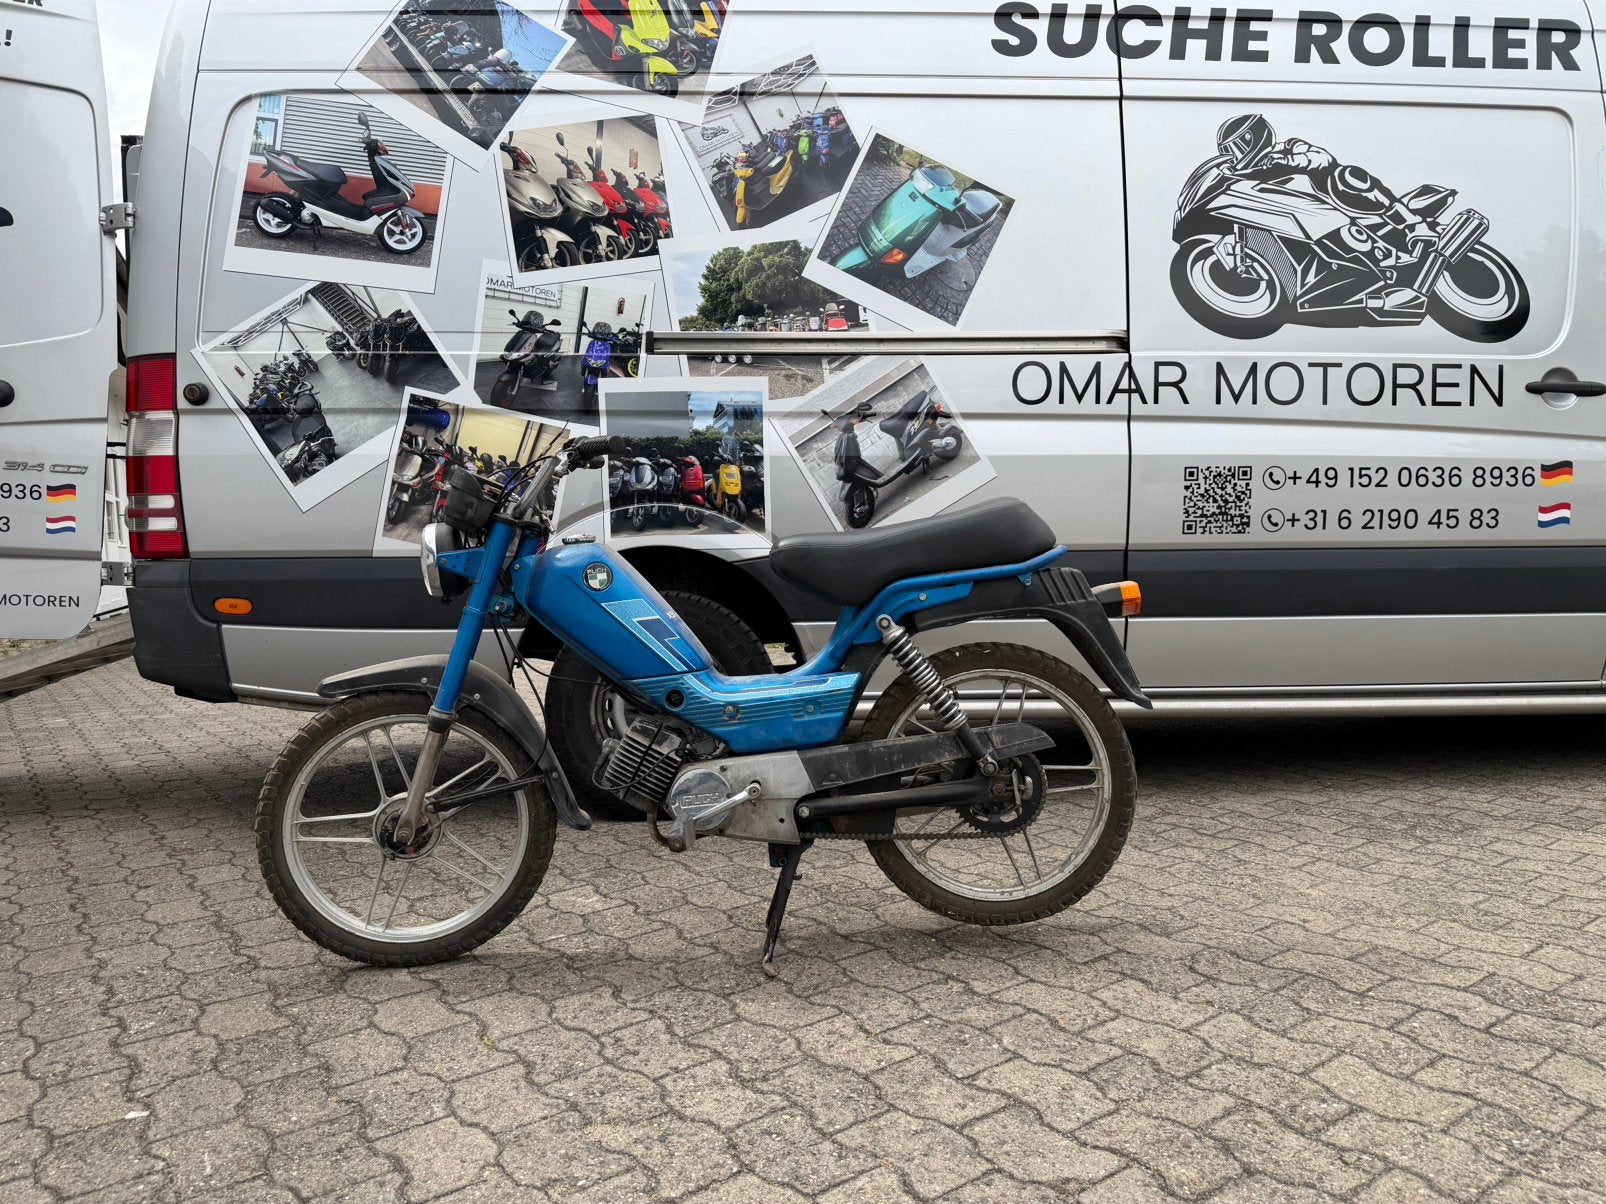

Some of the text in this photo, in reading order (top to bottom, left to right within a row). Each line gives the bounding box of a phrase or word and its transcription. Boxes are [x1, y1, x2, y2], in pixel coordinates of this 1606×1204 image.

[990, 1, 1582, 72] SUCHE ROLLER
[486, 277, 513, 289] MAR
[1011, 360, 1504, 408] OMAR MOTOREN
[2, 461, 45, 473] 314
[1287, 466, 1536, 488] +49 152 0636 8936
[0, 482, 42, 500] 936
[1286, 508, 1500, 531] +31 6 2190 45 83
[682, 792, 722, 806] PUCH
